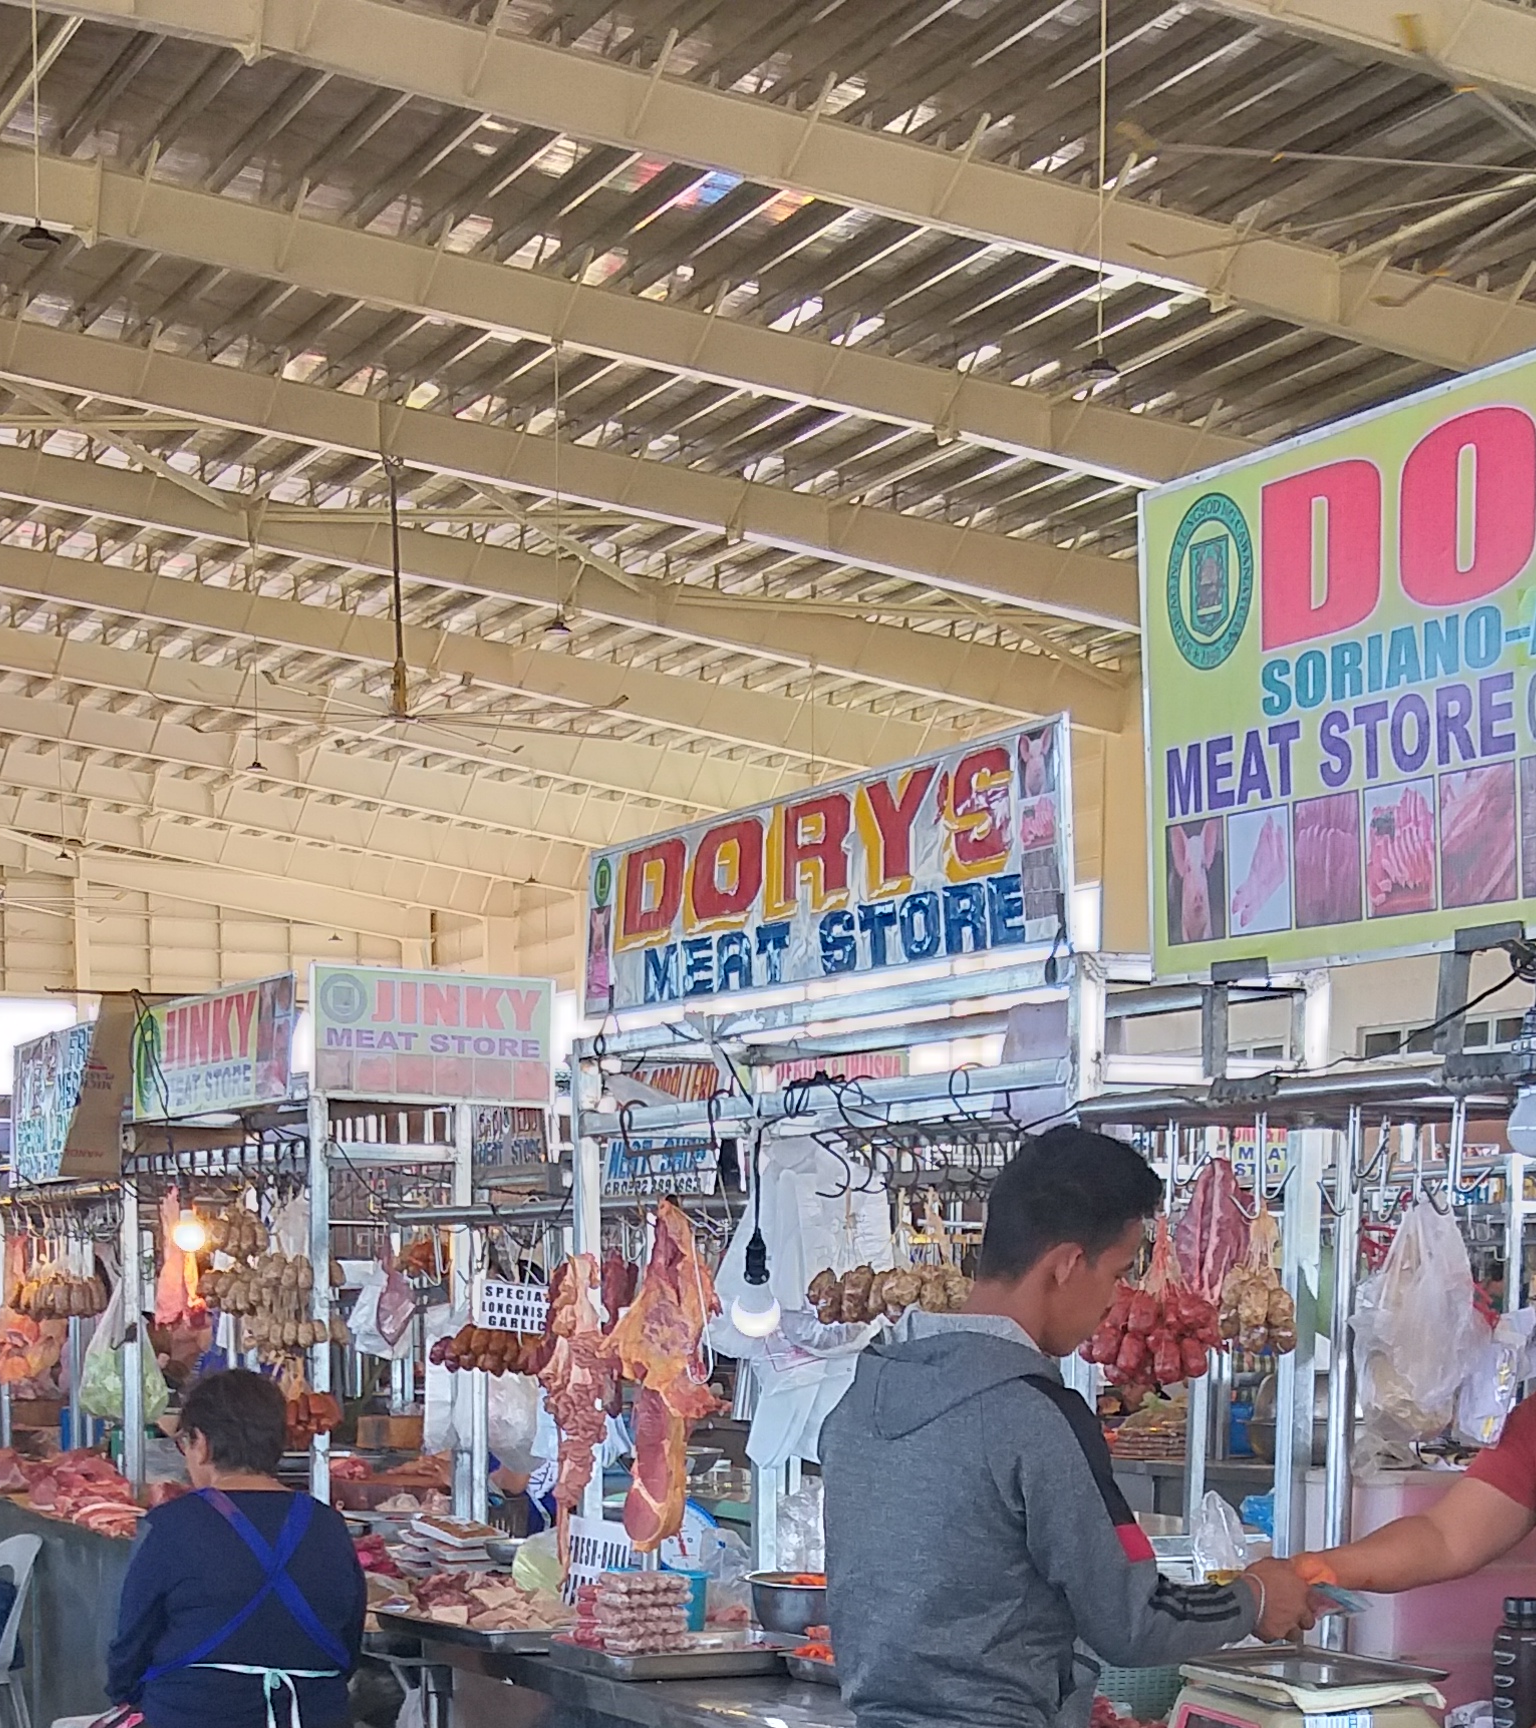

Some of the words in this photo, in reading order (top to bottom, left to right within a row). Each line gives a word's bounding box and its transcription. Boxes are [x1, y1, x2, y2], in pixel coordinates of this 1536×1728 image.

[1167, 722, 1302, 820] MEAT
[1319, 671, 1518, 788] STORE
[643, 920, 791, 1004] MEAT
[819, 872, 1025, 975] STORE
[371, 979, 543, 1033] JINKY
[163, 989, 259, 1074] JINKY
[326, 1026, 419, 1051] MEAT
[429, 1033, 541, 1059] STORE
[168, 1073, 201, 1108] EAT
[204, 1062, 253, 1102] STORE
[1238, 1146, 1288, 1161] MAT
[481, 1301, 549, 1319] LONGANIS
[487, 1314, 546, 1332] GARLIC
